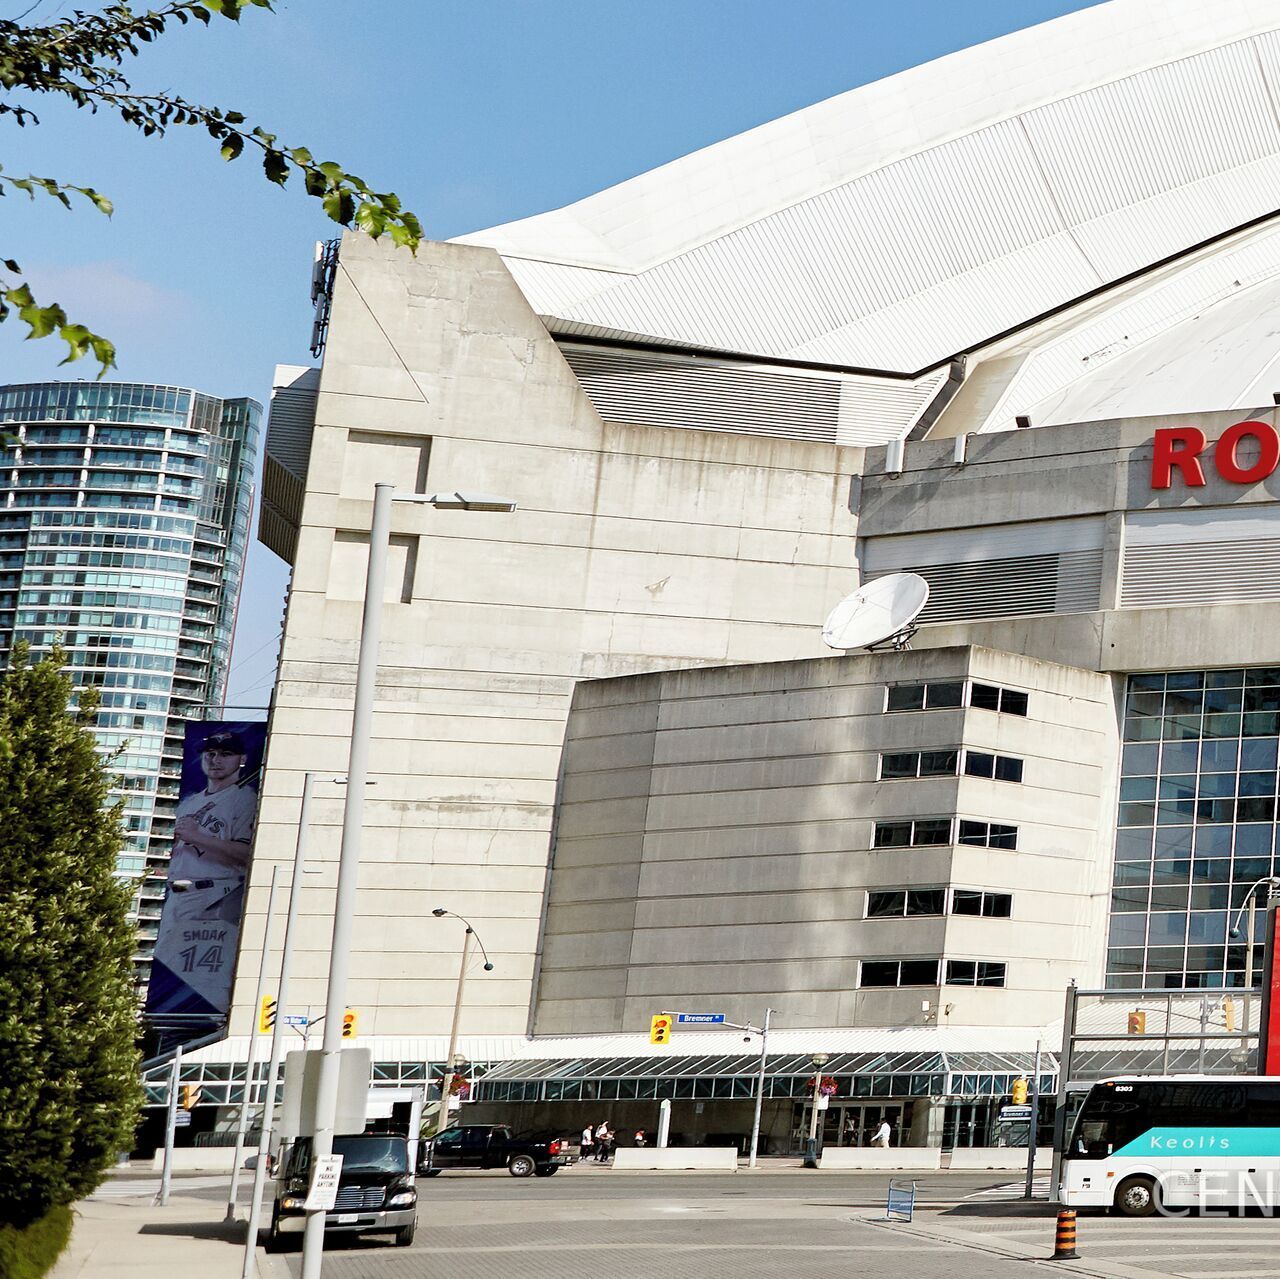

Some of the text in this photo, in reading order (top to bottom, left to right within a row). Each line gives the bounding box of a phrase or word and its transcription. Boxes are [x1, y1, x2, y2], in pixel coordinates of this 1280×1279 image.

[183, 929, 228, 943] SMOAK
[179, 945, 225, 973] 14
[684, 1014, 714, 1022] Bremner
[1150, 1135, 1231, 1149] Keolis
